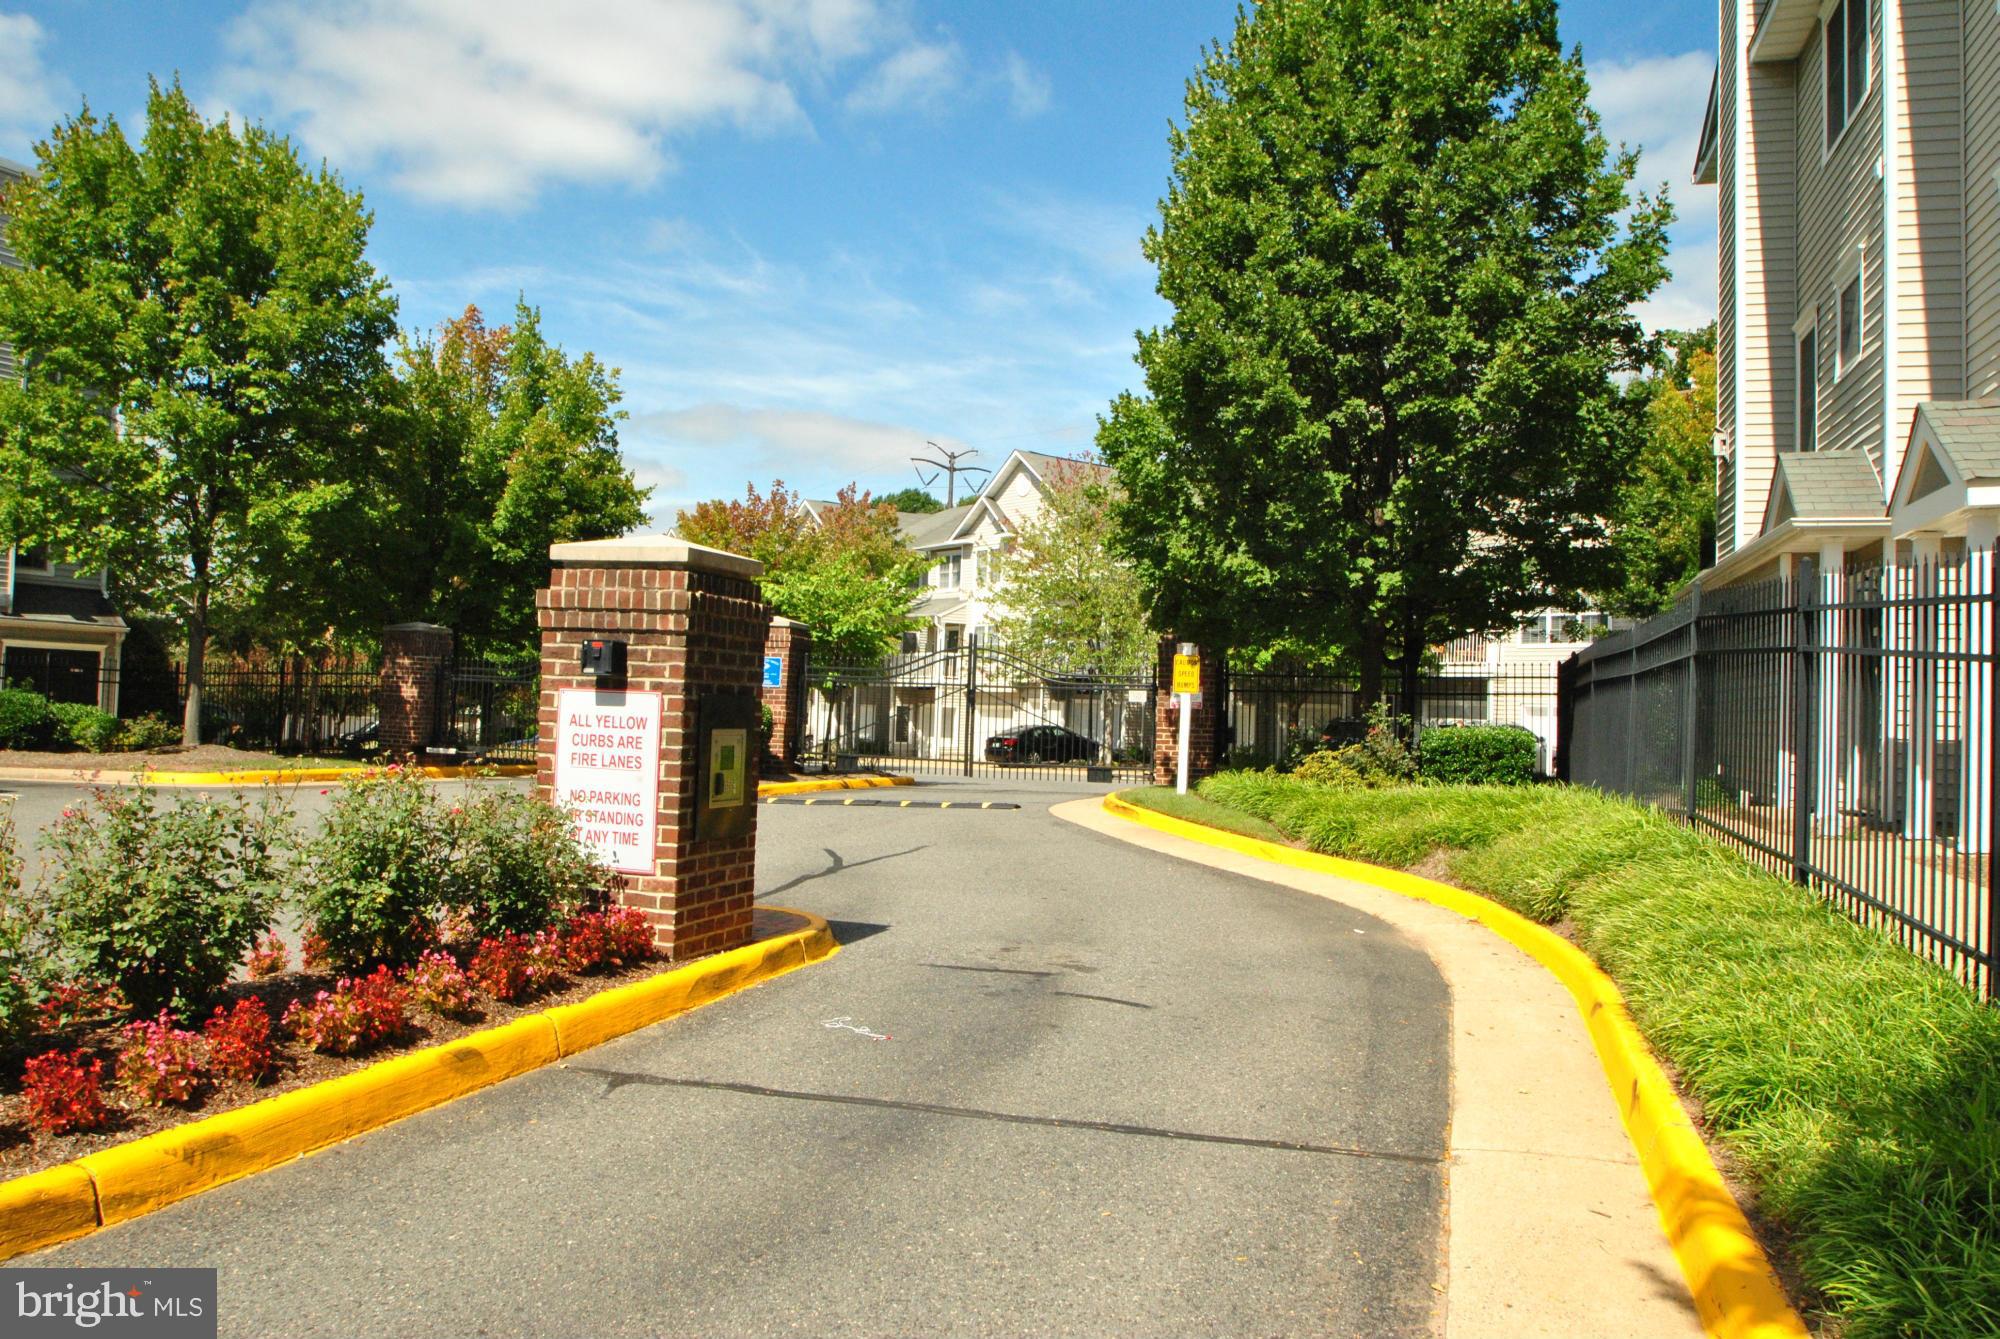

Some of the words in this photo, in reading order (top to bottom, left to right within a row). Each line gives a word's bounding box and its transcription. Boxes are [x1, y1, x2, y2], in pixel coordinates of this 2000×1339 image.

[569, 713, 592, 728] ALL
[596, 715, 647, 730] YELLOW
[572, 733, 614, 748] CURBS
[617, 735, 643, 750] ARE
[571, 752, 597, 767] FIRE
[601, 754, 642, 769] LANES
[570, 789, 586, 803] NO
[589, 790, 641, 807] PARKING
[585, 809, 644, 827] STANDING
[585, 829, 609, 844] ANY
[612, 831, 639, 846] TIME
